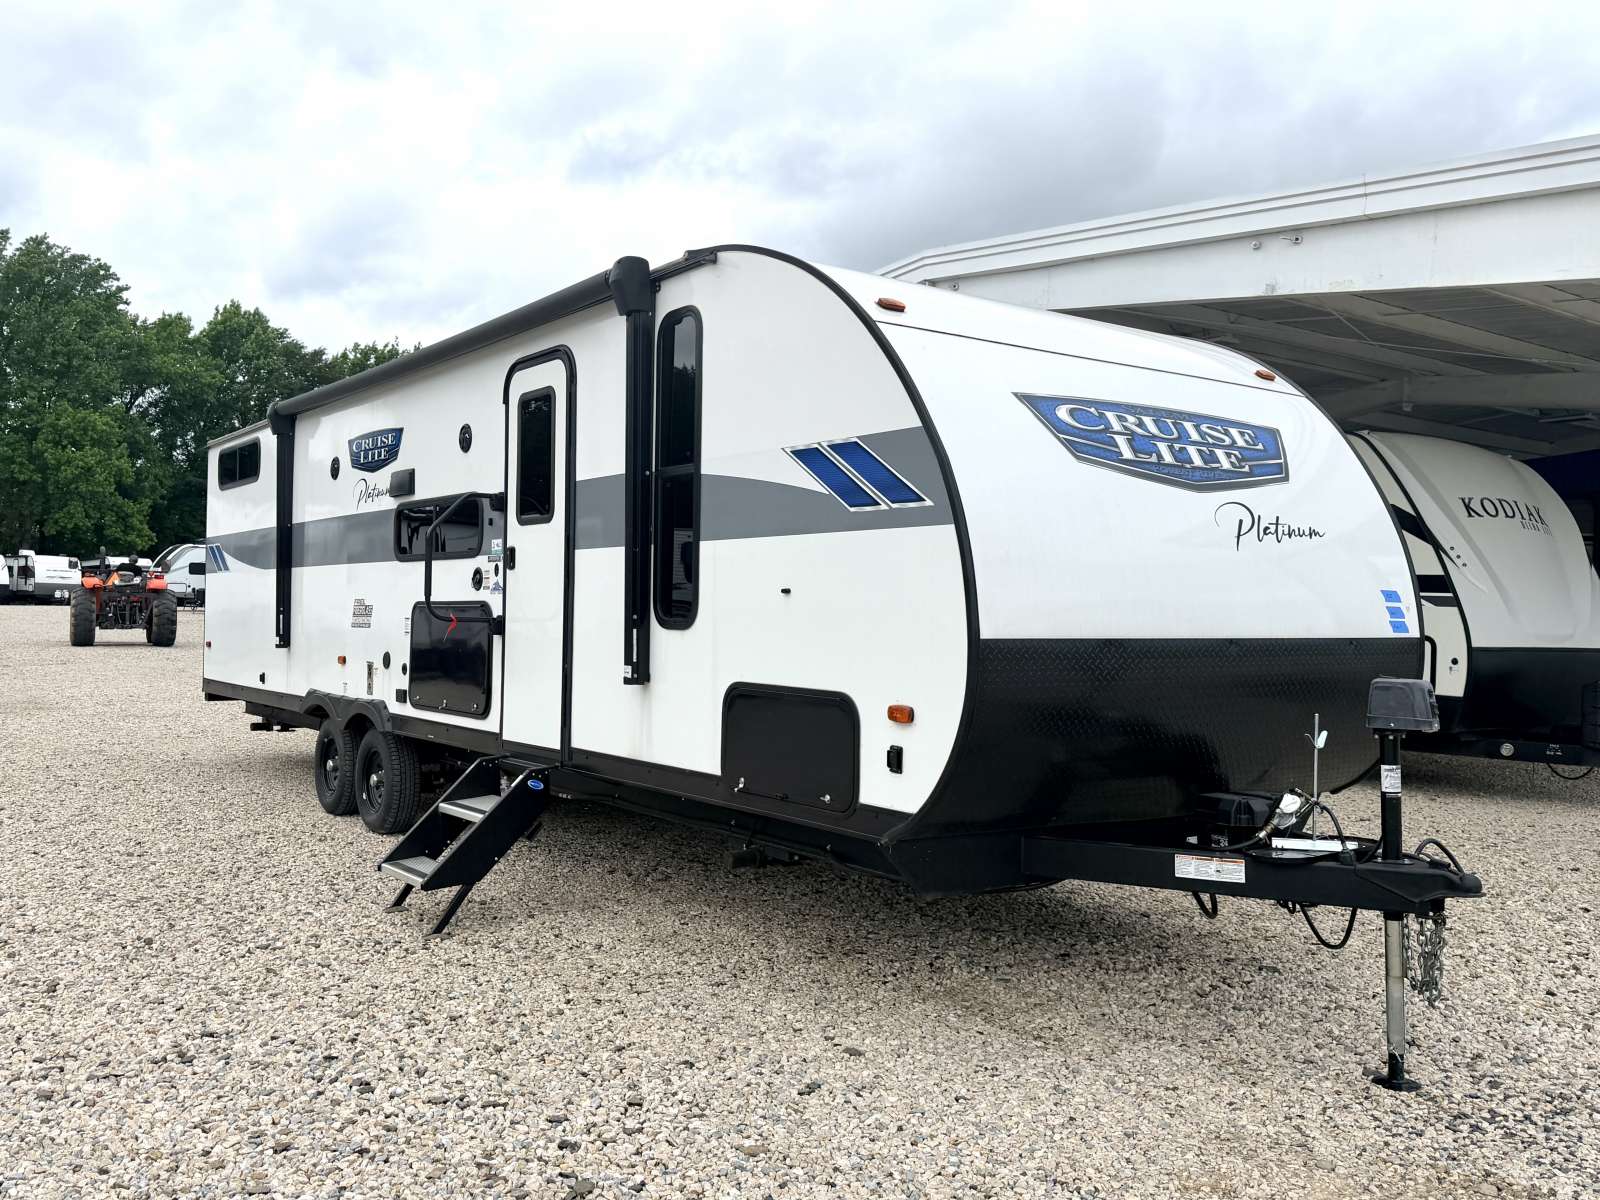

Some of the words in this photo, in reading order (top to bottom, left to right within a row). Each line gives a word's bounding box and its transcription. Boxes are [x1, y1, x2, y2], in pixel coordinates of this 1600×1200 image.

[352, 433, 396, 453] CRUISE
[1055, 404, 1265, 451] CRUISE
[360, 447, 389, 463] LITE
[1106, 433, 1251, 473] LITE
[1214, 501, 1326, 552] Platinum
[1458, 496, 1549, 527] KODIAK
